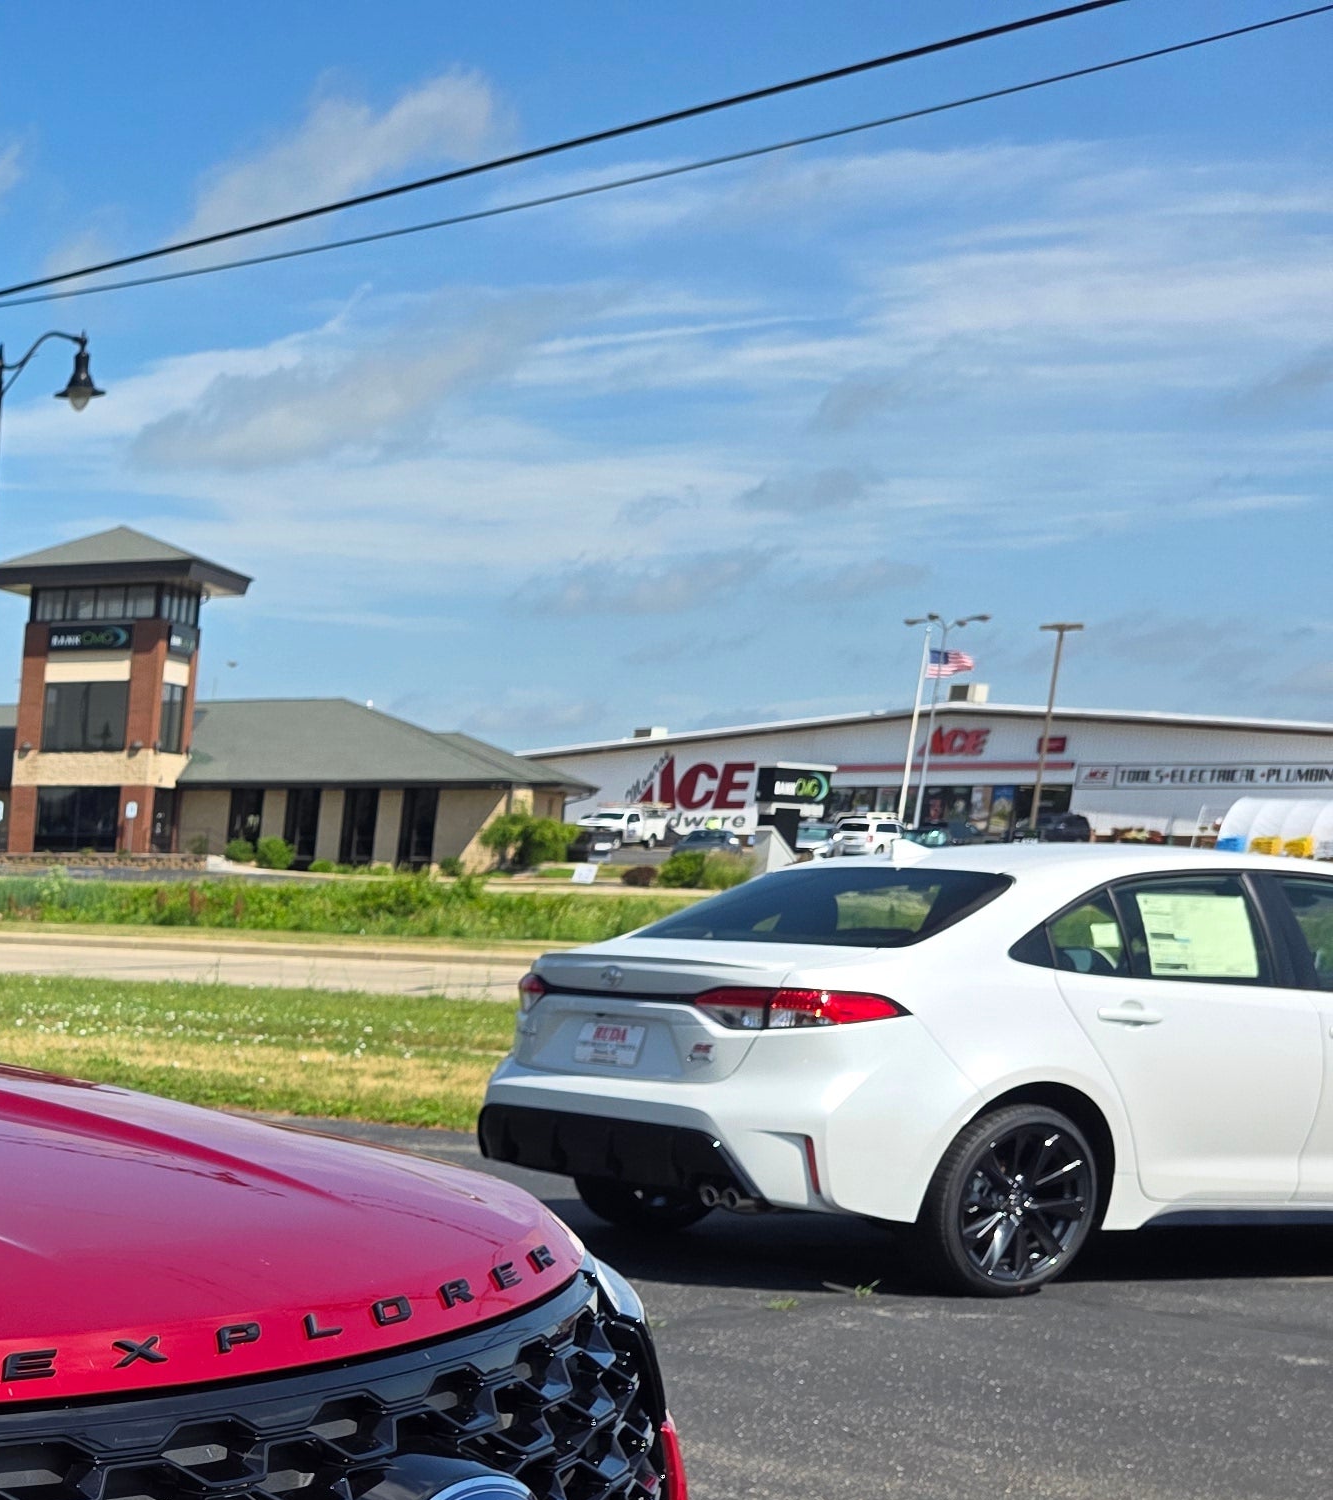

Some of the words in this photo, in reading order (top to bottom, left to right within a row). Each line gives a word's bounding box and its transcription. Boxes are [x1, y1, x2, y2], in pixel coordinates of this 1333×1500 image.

[918, 726, 991, 756] ACE
[639, 755, 756, 810] ACE
[2, 1245, 557, 1382] EXPLORER
